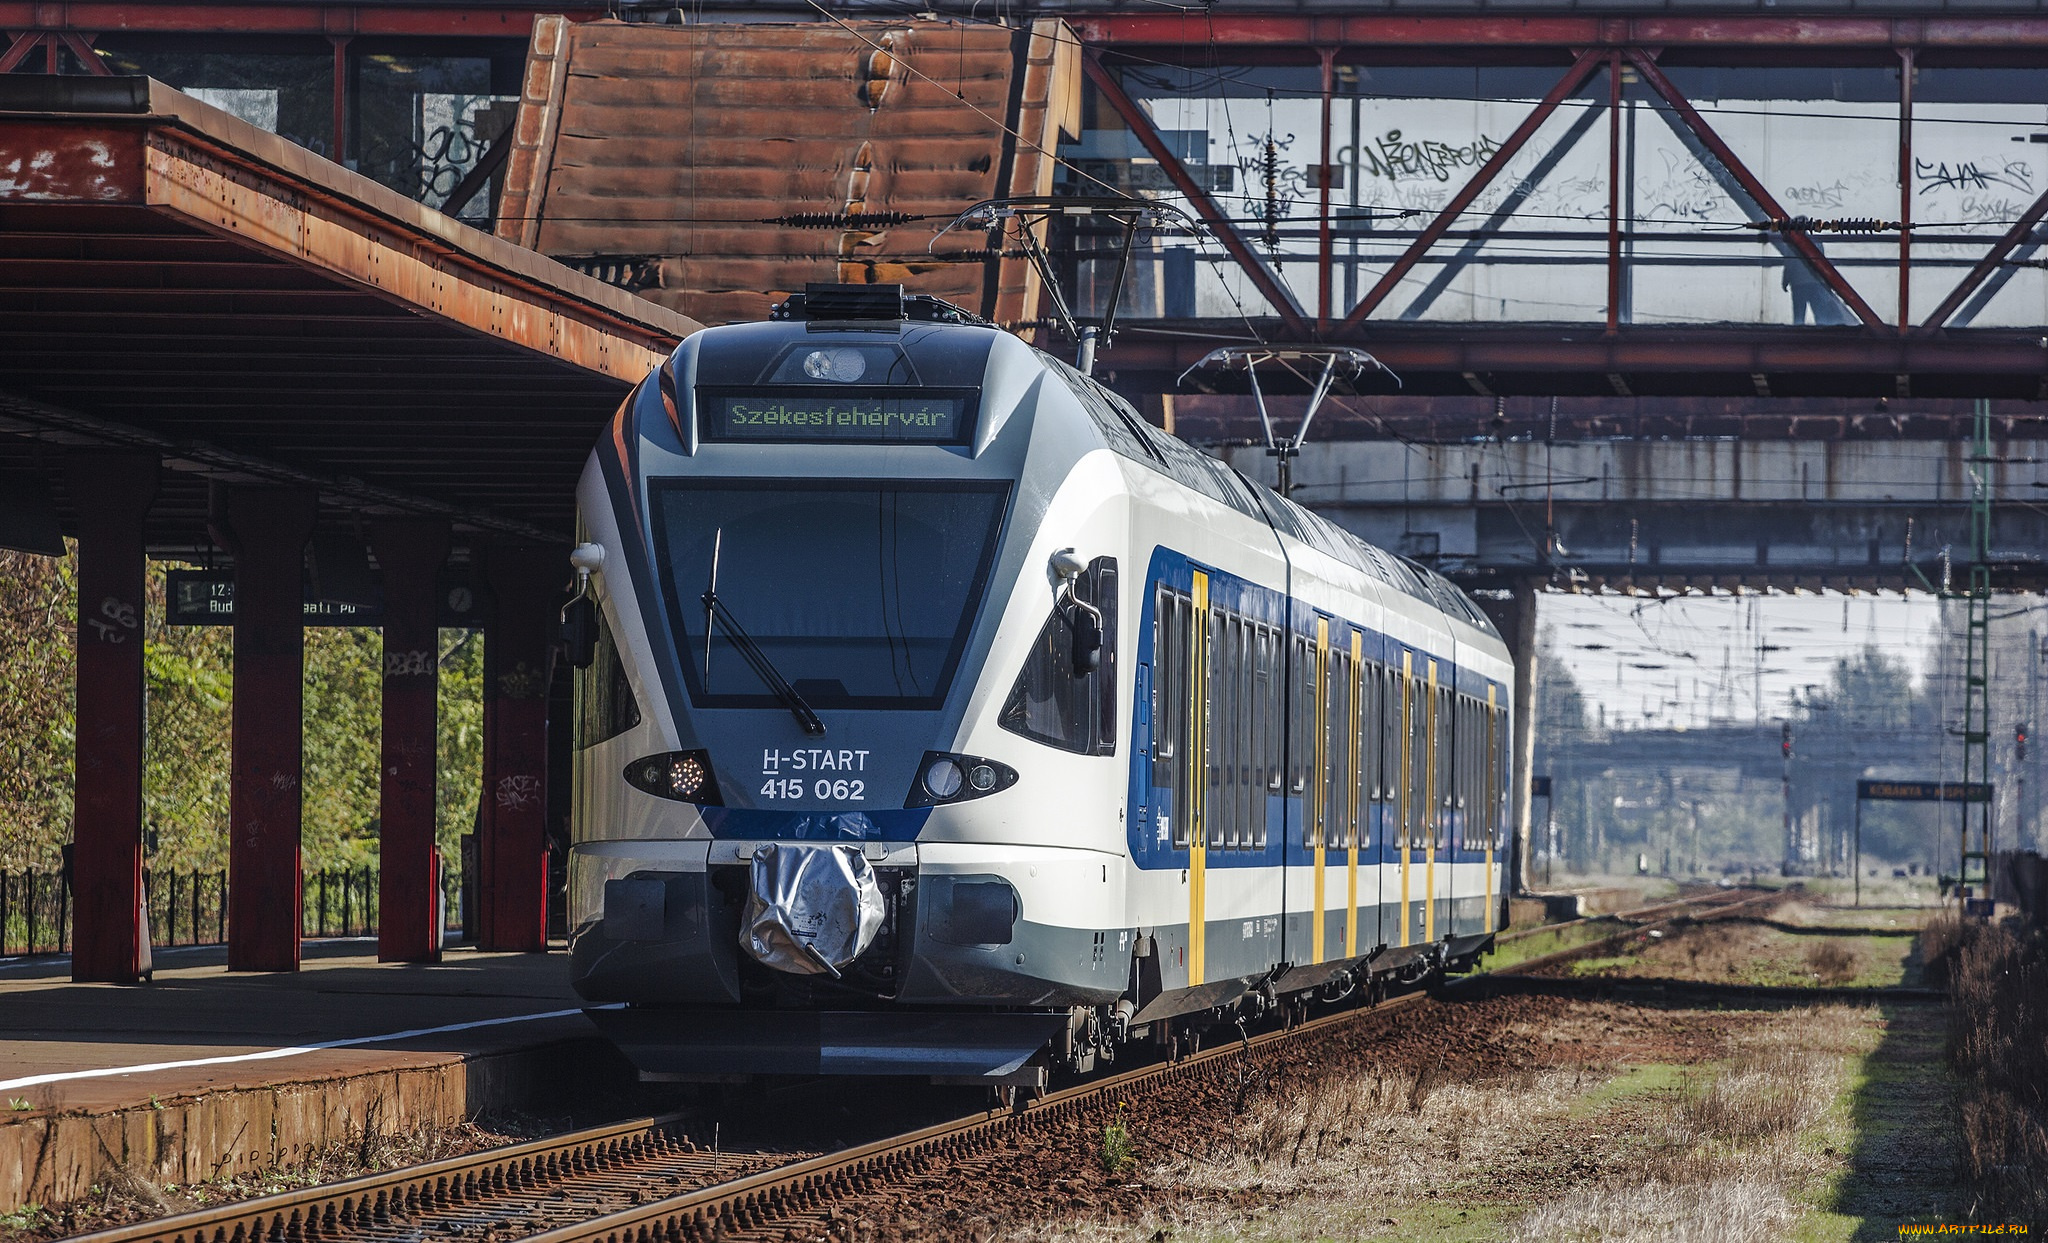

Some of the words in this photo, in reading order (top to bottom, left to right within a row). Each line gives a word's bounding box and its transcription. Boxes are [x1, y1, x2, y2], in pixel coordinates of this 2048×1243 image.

[732, 404, 947, 427] Székesfehérvár
[211, 584, 232, 597] 12:
[210, 600, 233, 613] Bud
[763, 749, 869, 774] H-START
[760, 779, 804, 799] 415
[814, 779, 865, 801] 062
